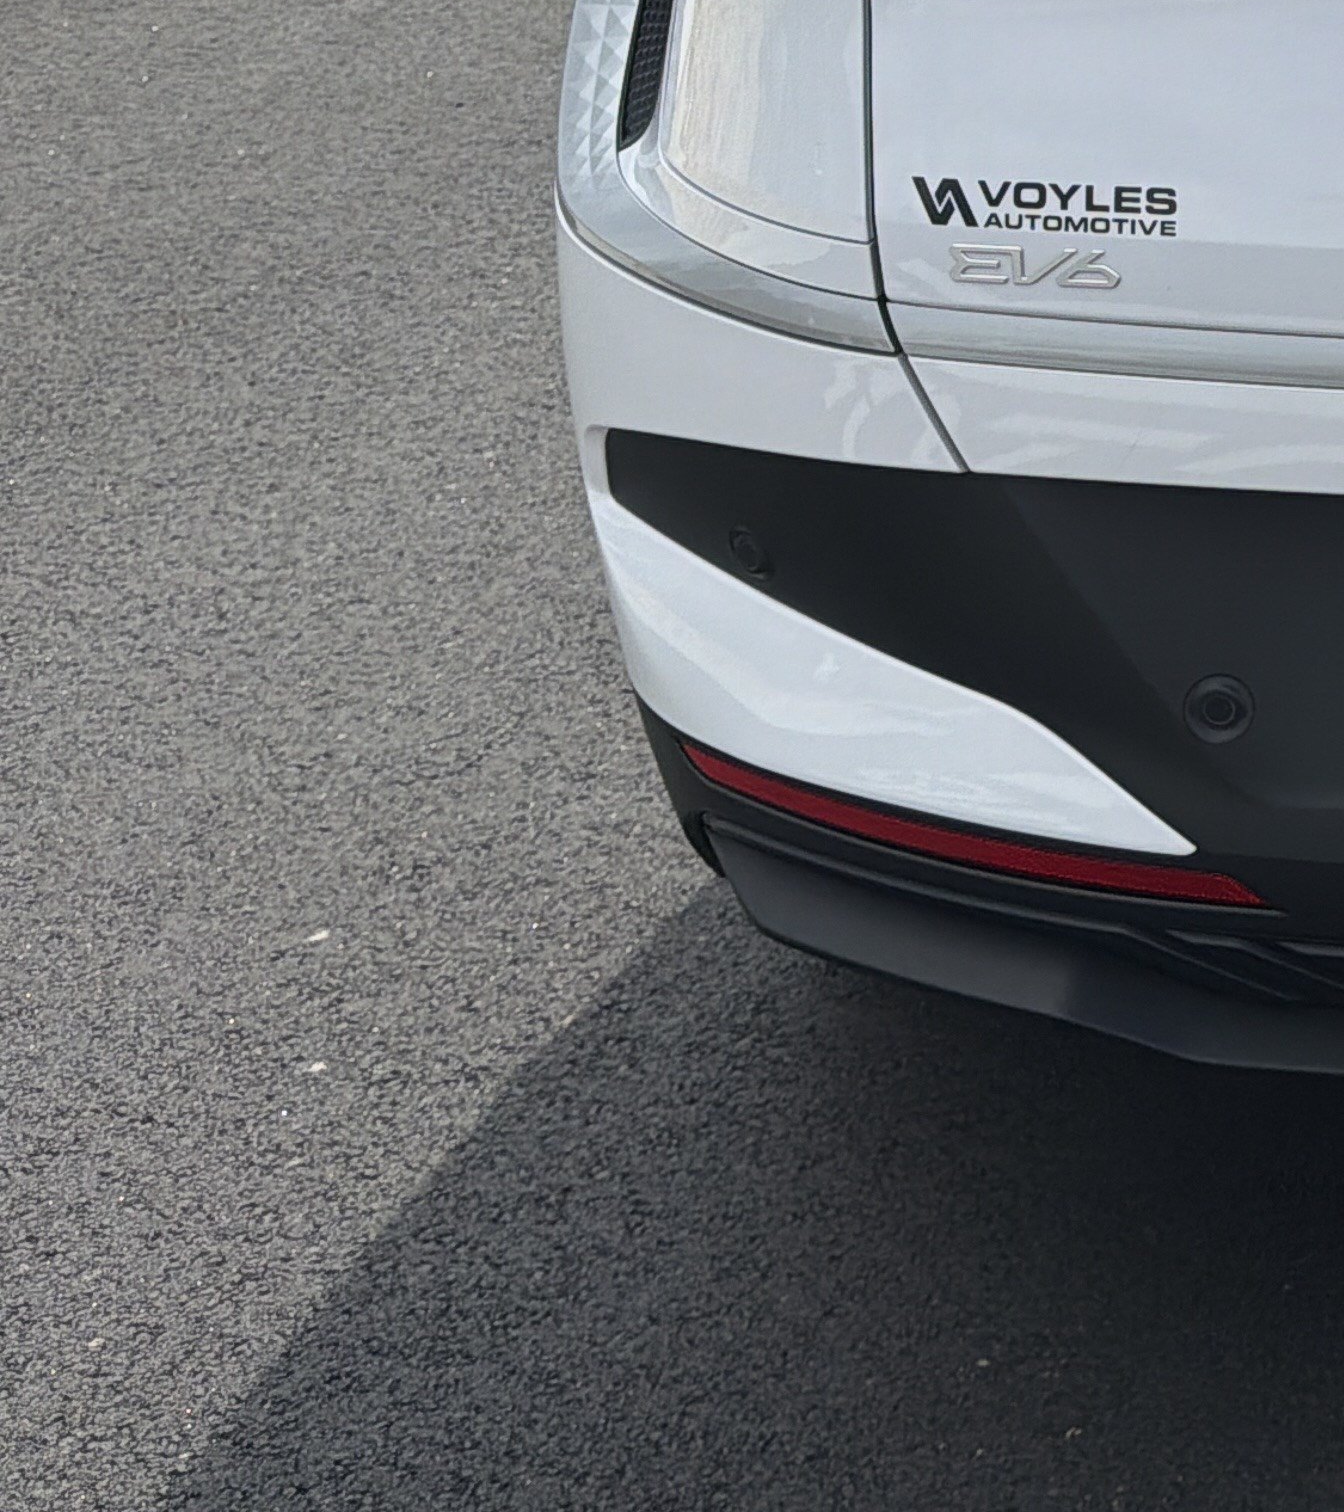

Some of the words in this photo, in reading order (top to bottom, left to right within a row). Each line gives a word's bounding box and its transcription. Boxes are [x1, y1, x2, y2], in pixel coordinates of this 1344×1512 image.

[977, 179, 1178, 216] VOYLES
[983, 212, 1178, 237] AUTOMOTIVE
[948, 242, 1122, 290] EV6
